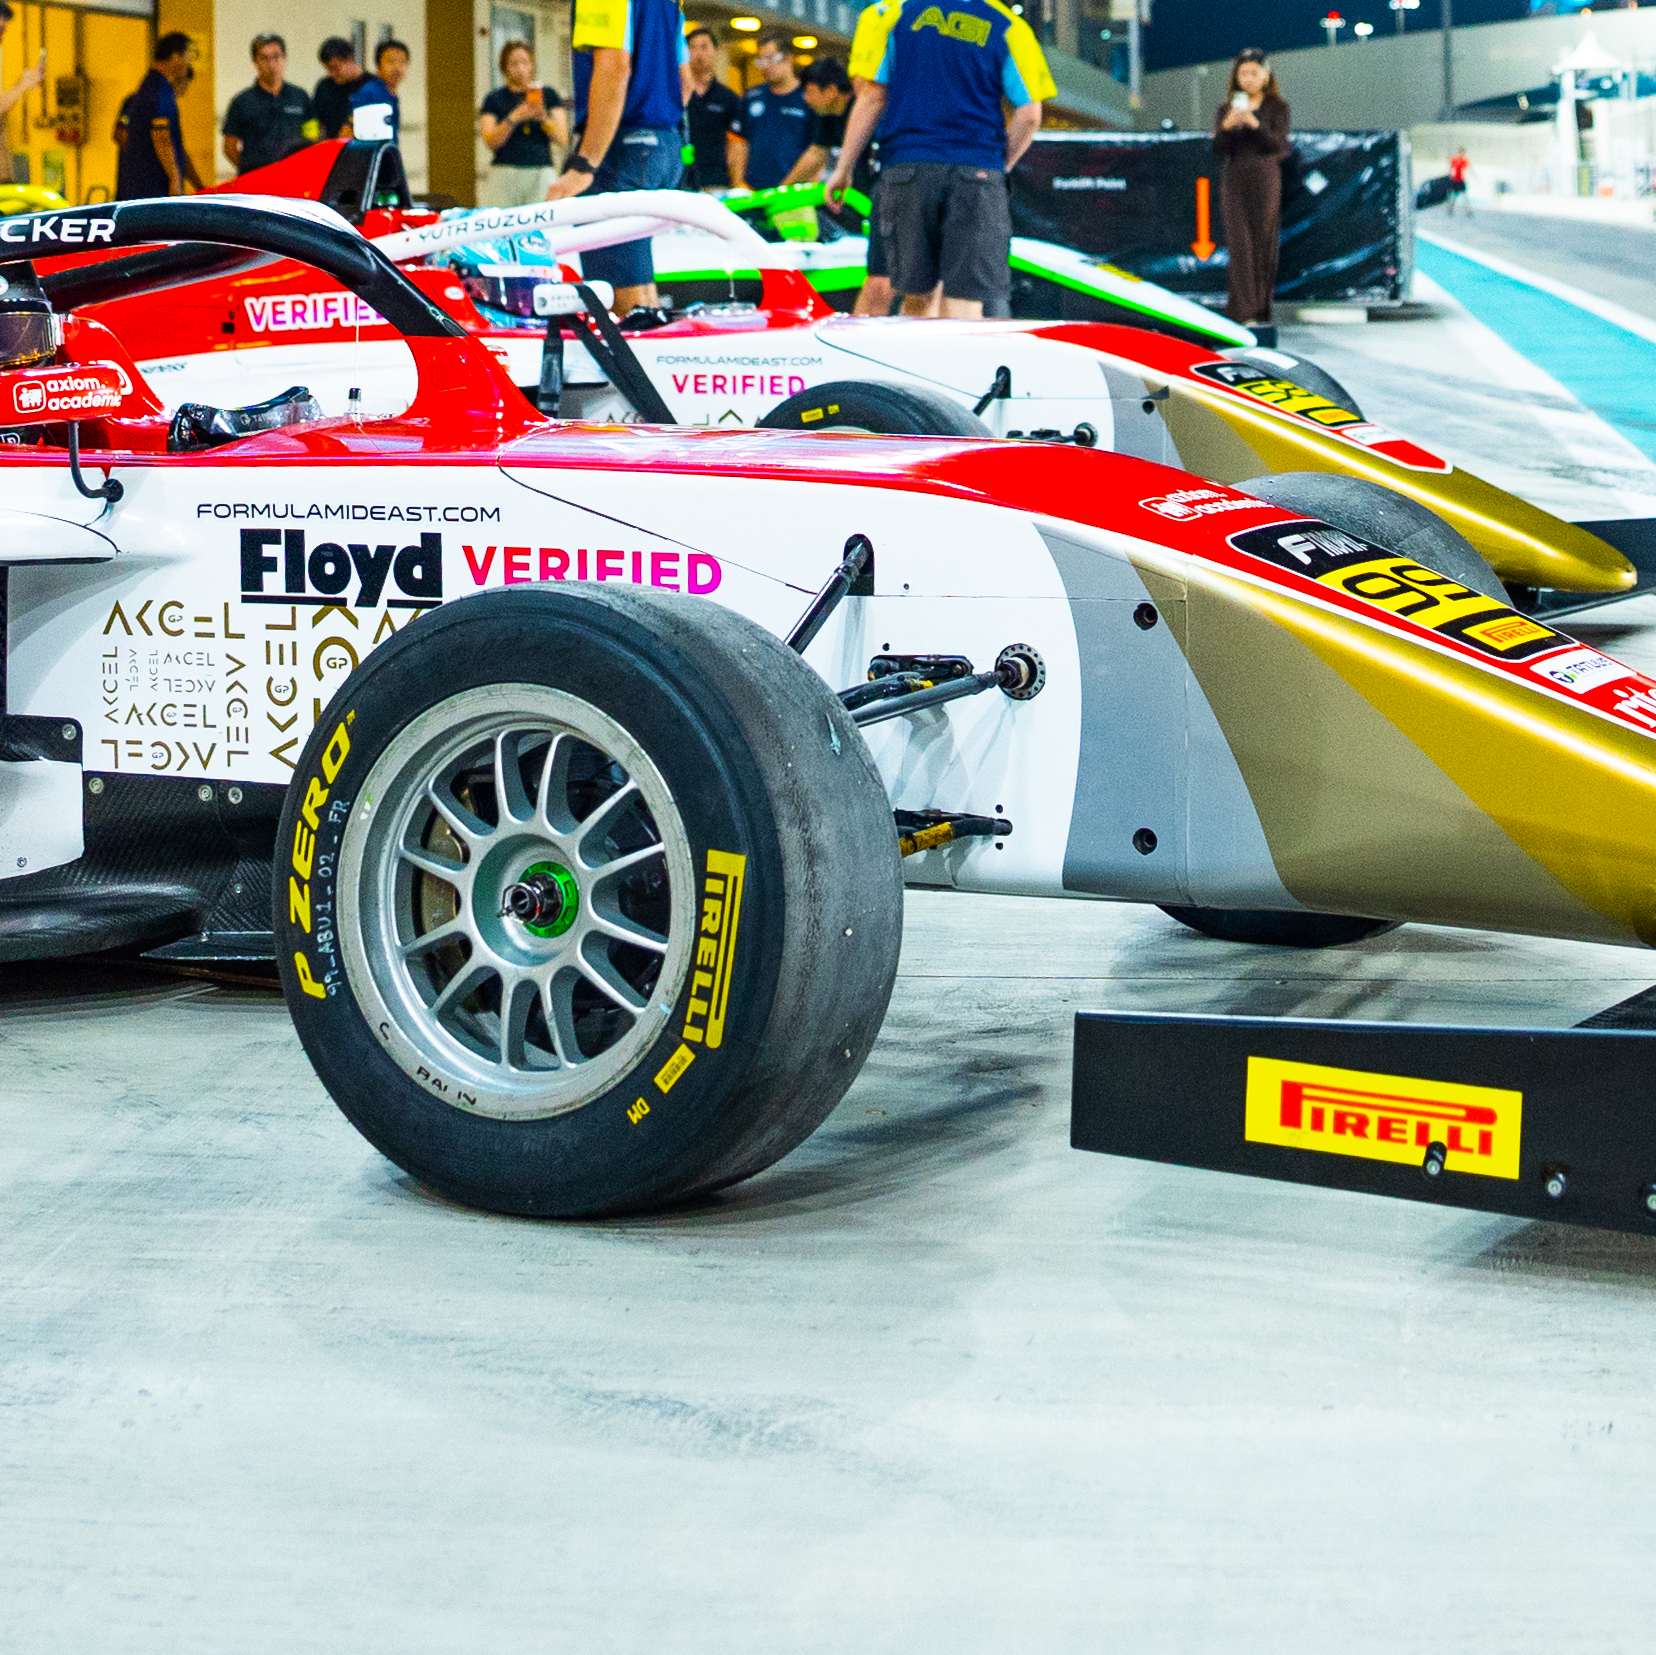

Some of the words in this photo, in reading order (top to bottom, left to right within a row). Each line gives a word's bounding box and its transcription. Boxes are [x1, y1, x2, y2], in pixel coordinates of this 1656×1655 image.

[419, 221, 469, 243] YUTA
[475, 208, 554, 233] SUZUKI
[46, 375, 107, 393] axiom.
[672, 373, 805, 396] VERIFIED
[196, 502, 501, 523] FORMULAMIDEAST.COM
[241, 528, 443, 608] Floyd
[462, 544, 723, 594] VERIFIED
[289, 721, 352, 934] ZERO
[682, 848, 747, 1049] PIRELLI
[294, 950, 327, 1000] P
[1279, 1079, 1498, 1158] PIRELLI
